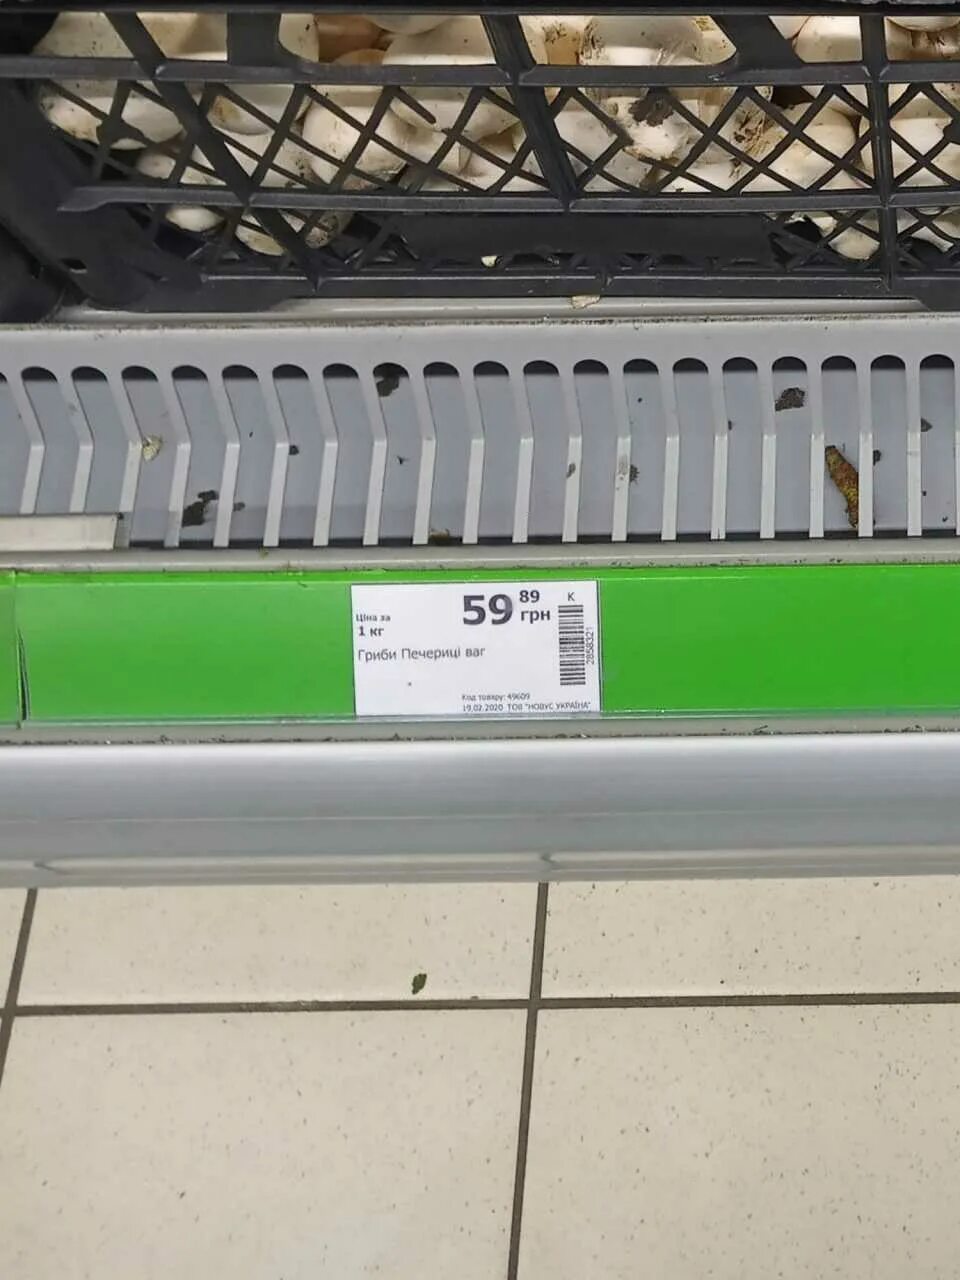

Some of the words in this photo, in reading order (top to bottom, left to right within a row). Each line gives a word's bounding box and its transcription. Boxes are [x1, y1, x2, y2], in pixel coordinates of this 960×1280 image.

[519, 590, 540, 603] 89
[462, 593, 513, 625] 59
[520, 608, 551, 624] грн
[355, 614, 378, 623] Ціна
[358, 625, 366, 637] 1
[370, 627, 385, 637] кг
[358, 648, 397, 662] Гриби
[401, 647, 462, 661] Печериці
[465, 648, 486, 658] ваг
